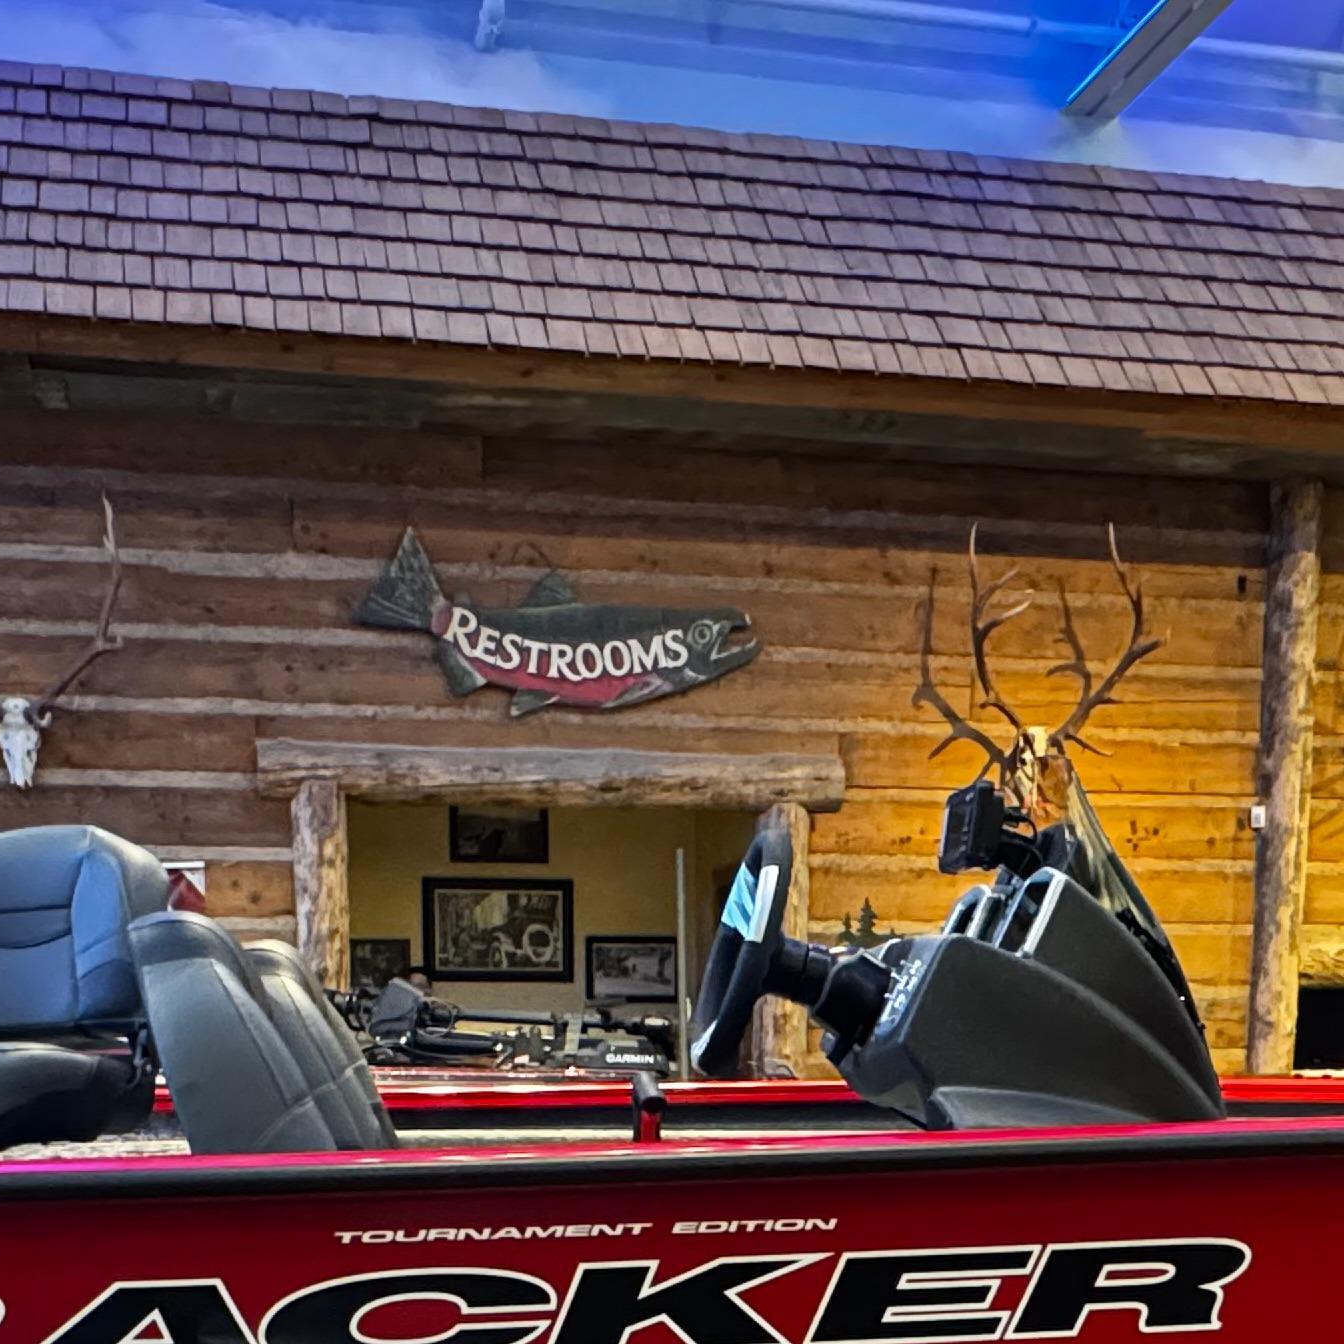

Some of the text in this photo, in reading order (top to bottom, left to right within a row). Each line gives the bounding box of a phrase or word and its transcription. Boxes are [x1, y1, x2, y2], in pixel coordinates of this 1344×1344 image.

[442, 606, 689, 682] RESTROOMS
[605, 1053, 655, 1064] GARMIN
[333, 1218, 839, 1245] TOURNAMENT EDITION
